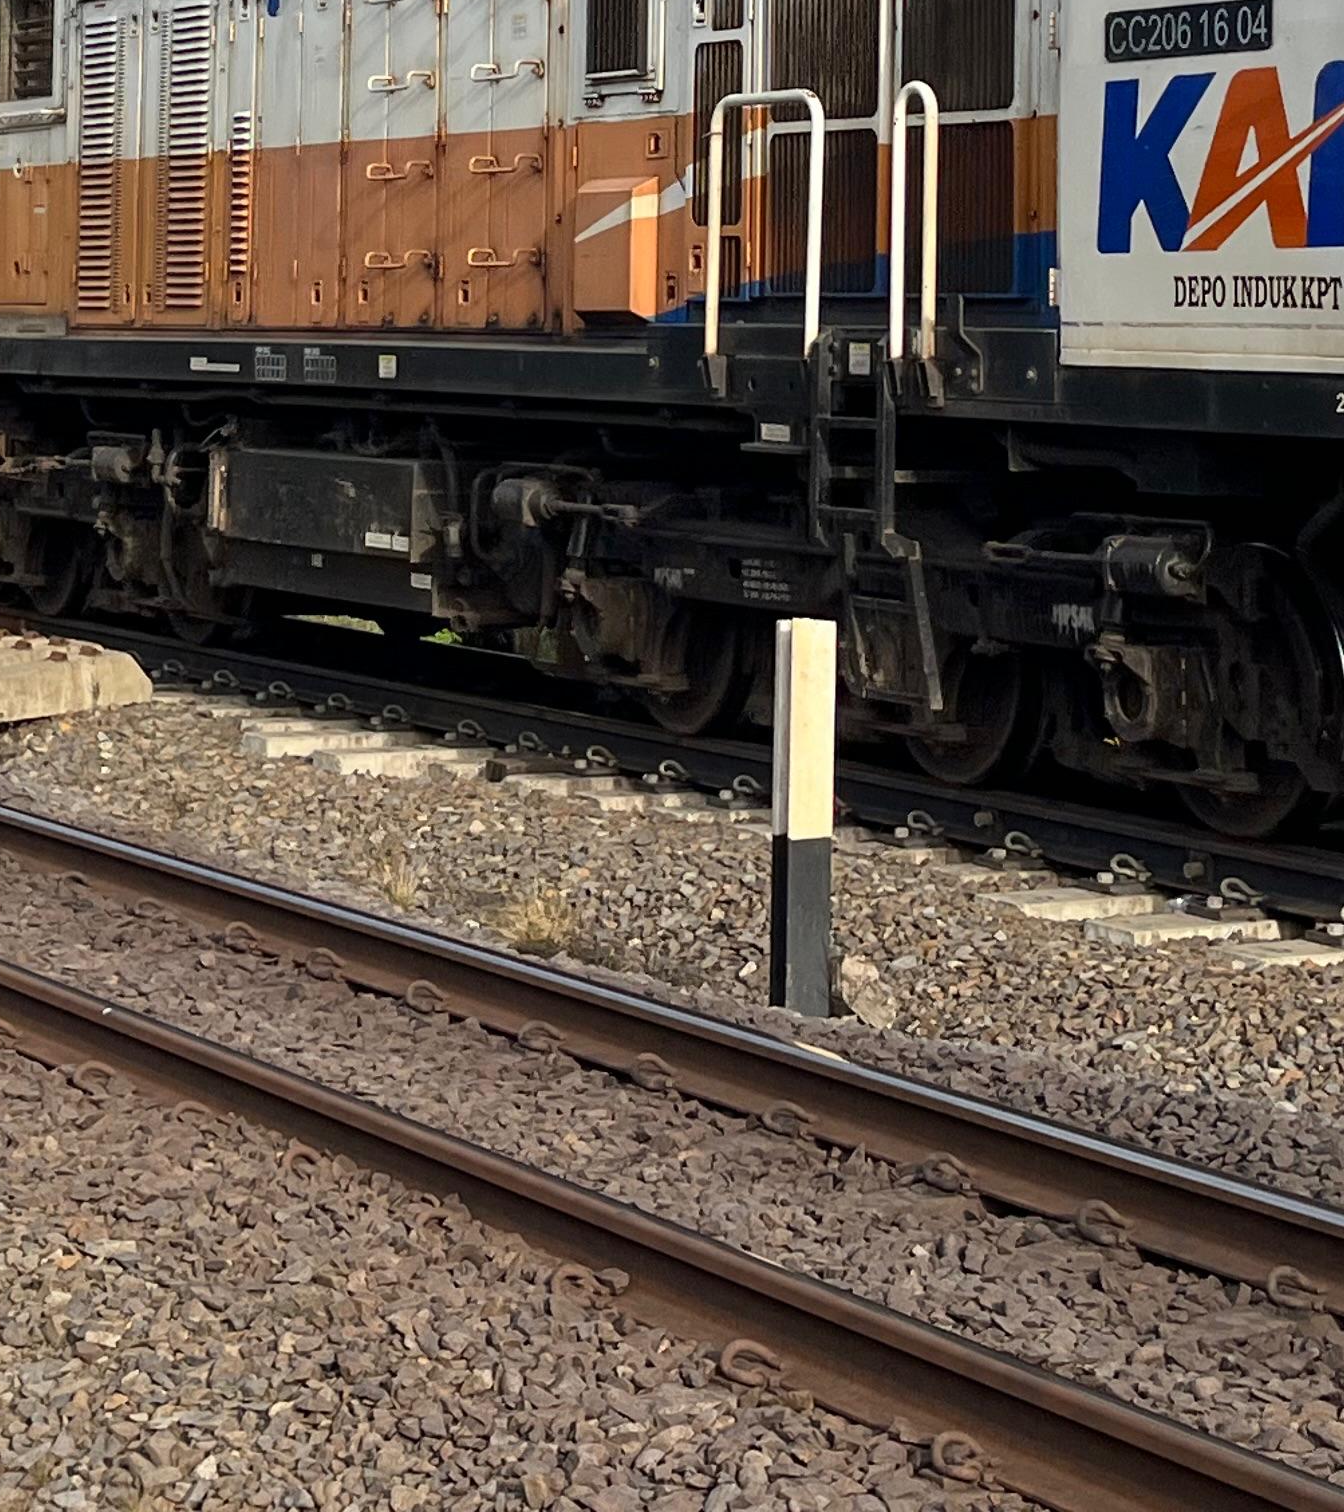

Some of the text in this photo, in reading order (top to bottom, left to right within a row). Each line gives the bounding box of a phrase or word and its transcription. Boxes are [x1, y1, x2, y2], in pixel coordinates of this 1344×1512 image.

[1109, 4, 1268, 54] CC206 16 04
[1174, 276, 1343, 310] DEPO INDUK KPT
